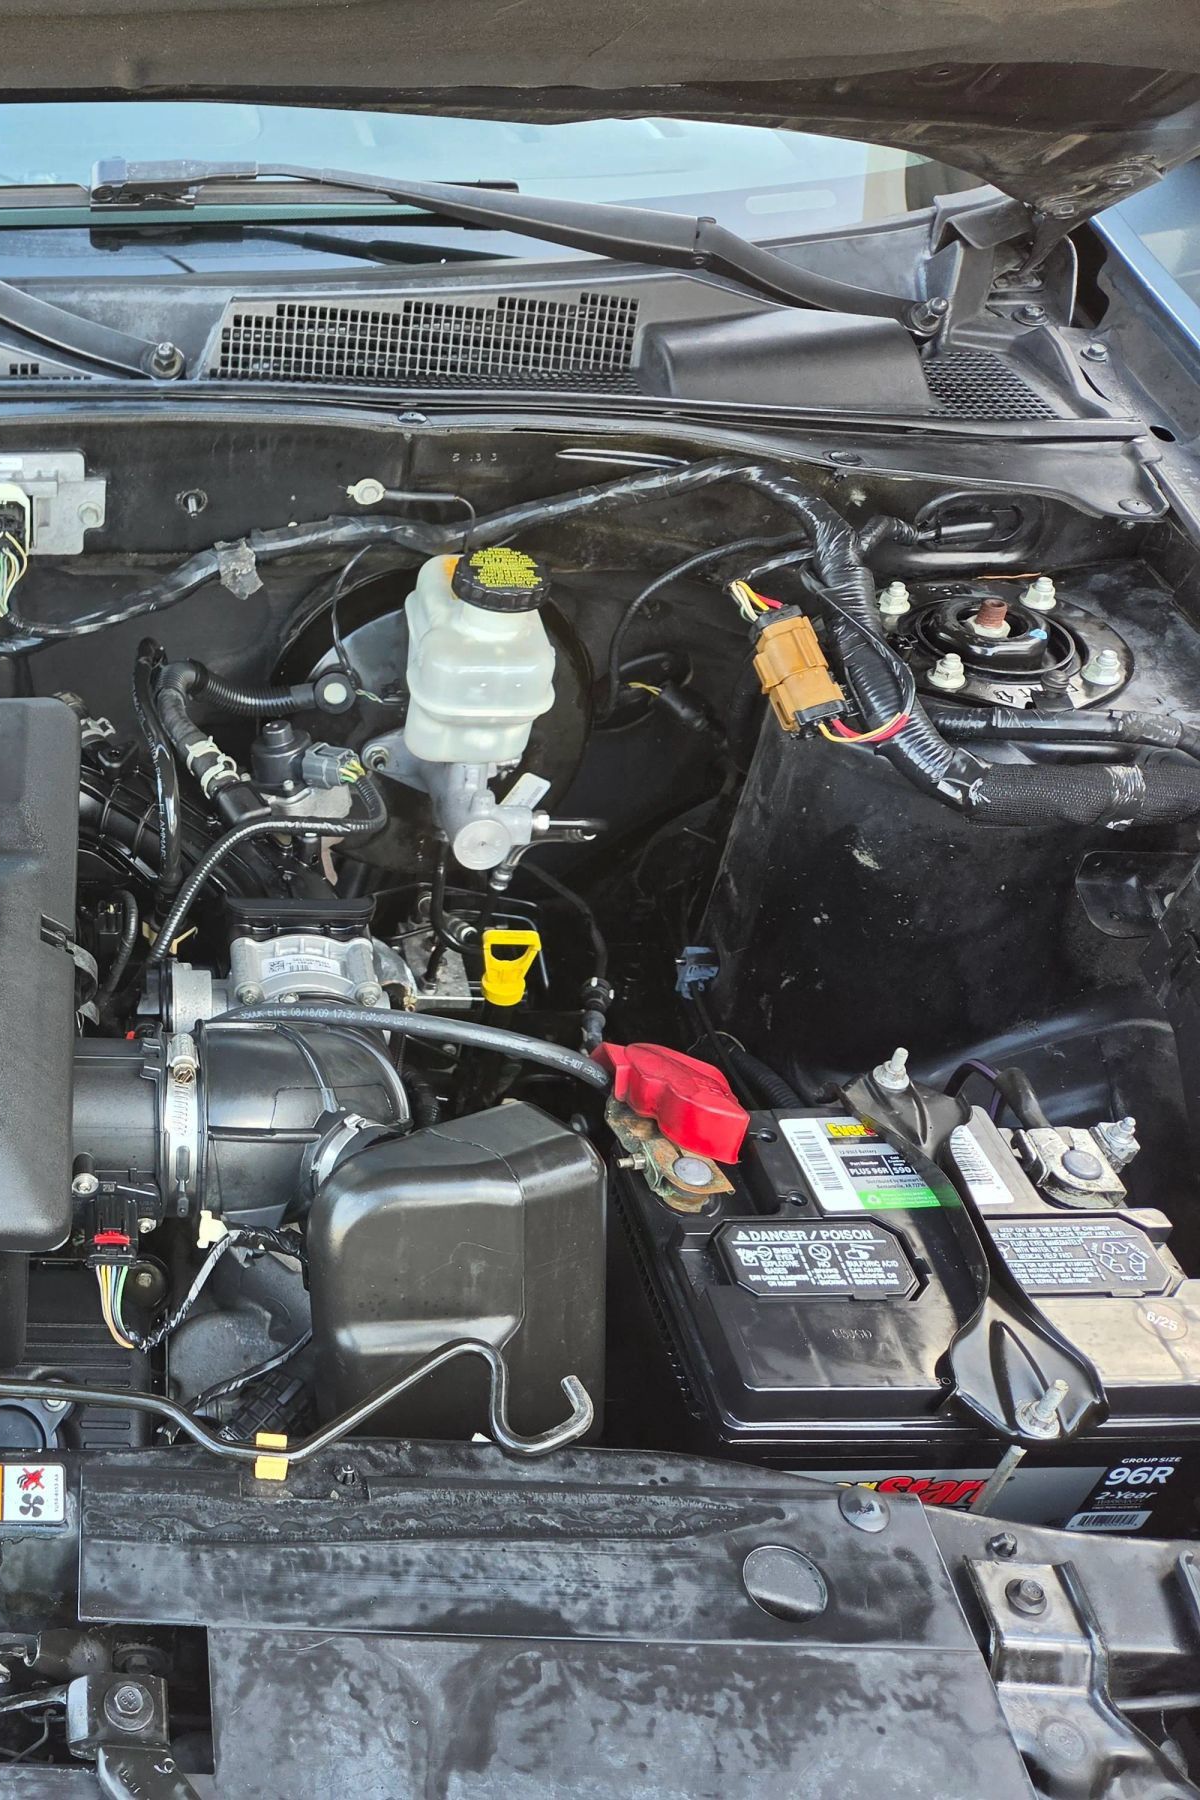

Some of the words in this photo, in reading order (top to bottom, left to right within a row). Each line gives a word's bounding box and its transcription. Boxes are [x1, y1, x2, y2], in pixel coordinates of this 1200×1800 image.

[872, 1167, 890, 1175] 96R
[893, 1166, 912, 1174] 590
[749, 1230, 807, 1241] DANGER
[809, 1230, 817, 1240] /
[821, 1229, 874, 1240] POISON
[1044, 1238, 1084, 1246] IMMEDIATELY
[881, 1260, 899, 1268] ACID
[1146, 1310, 1179, 1332] 6/25
[1104, 1466, 1175, 1486] 96R
[1094, 1490, 1158, 1500] 2-Year
